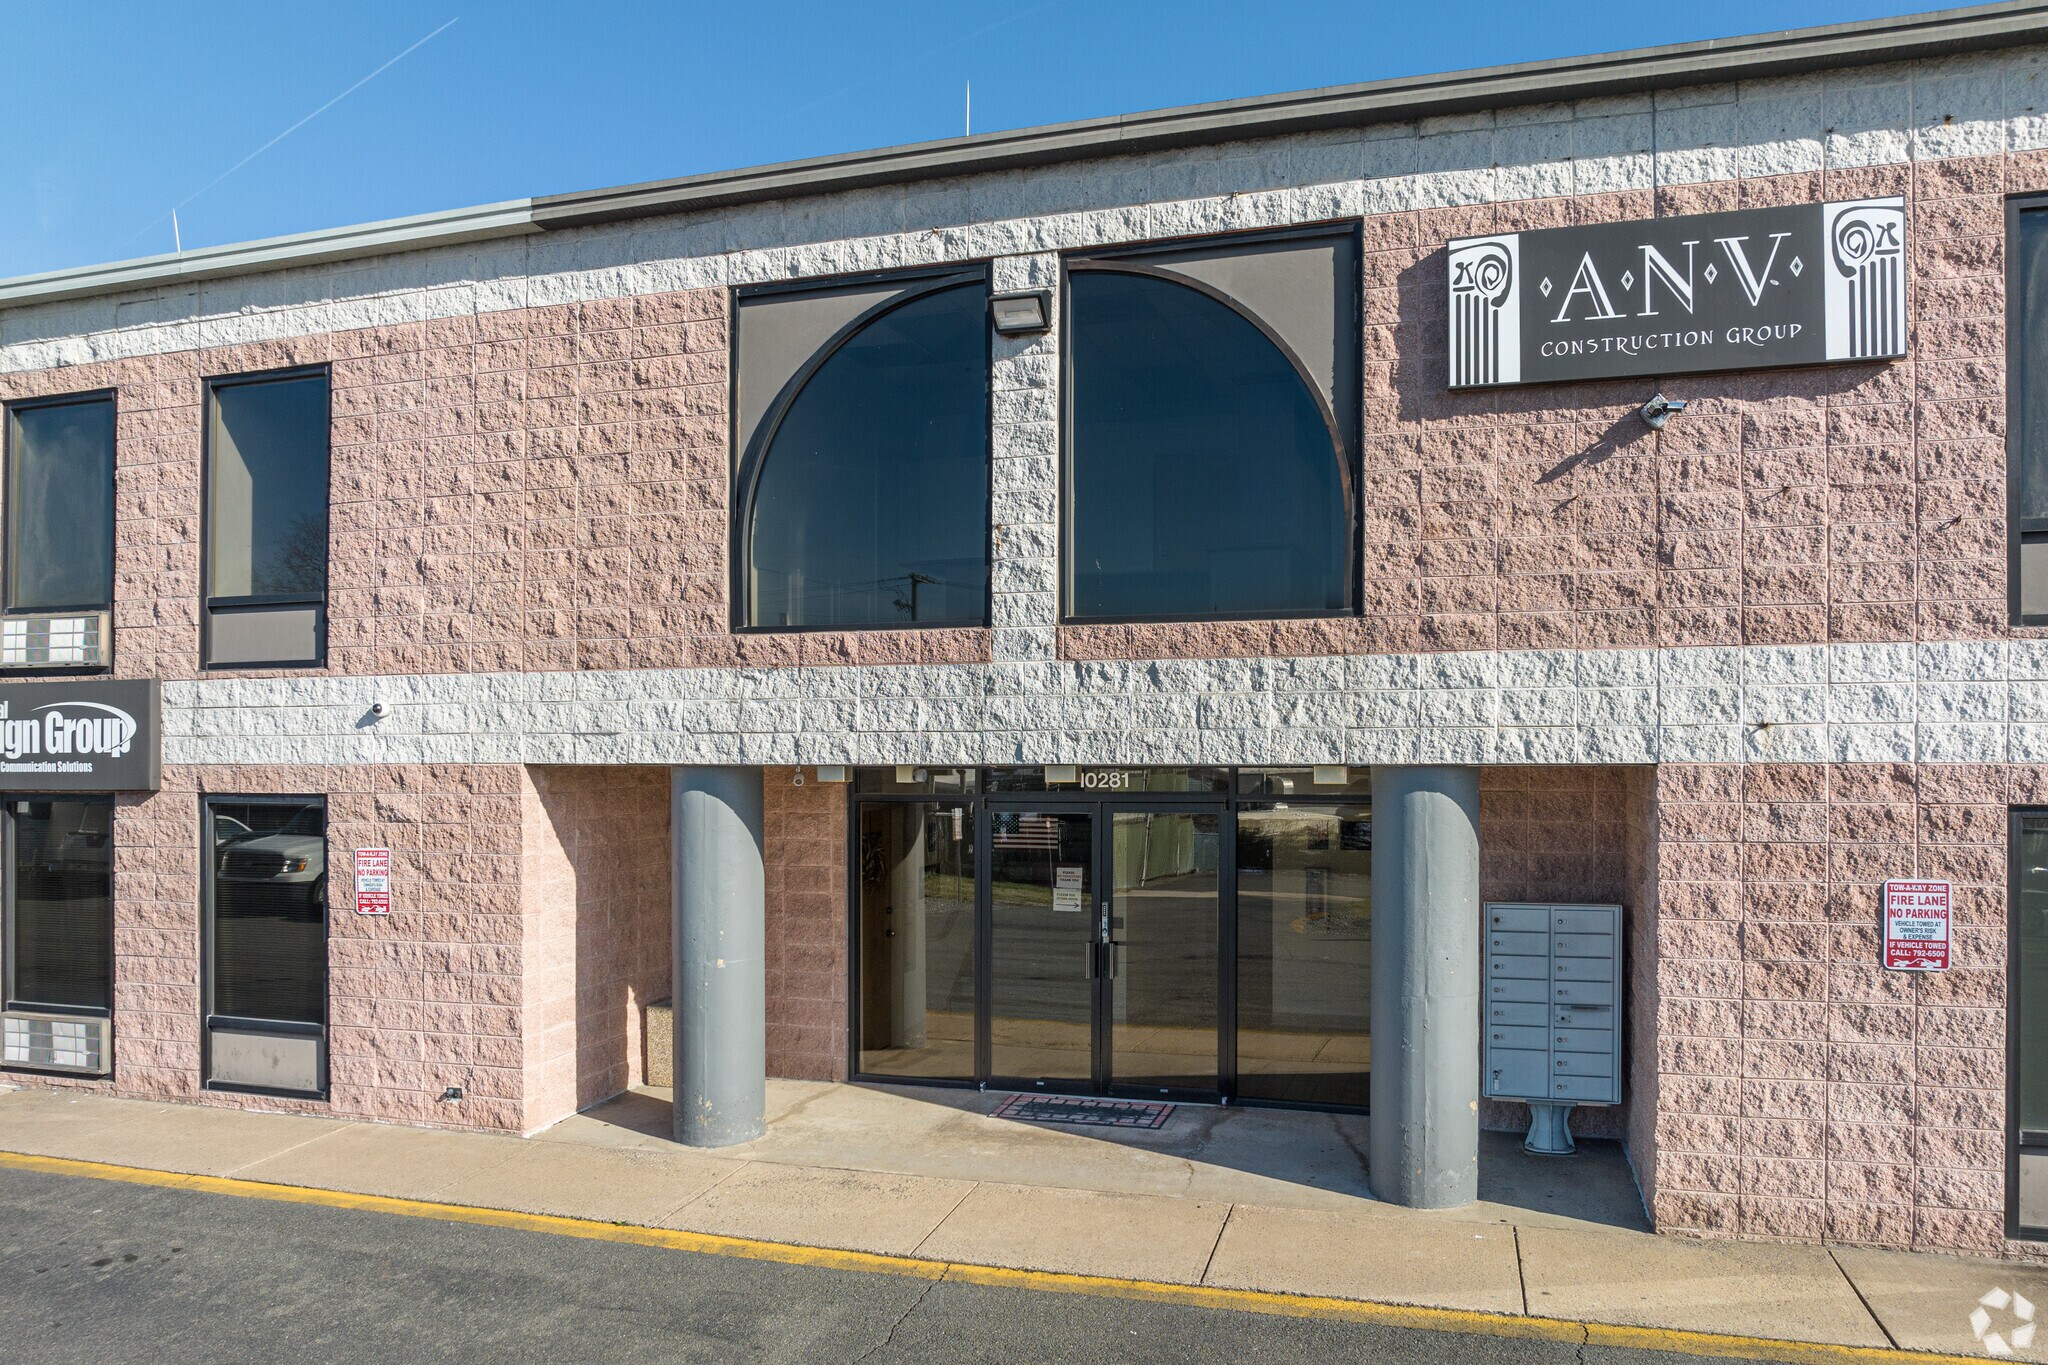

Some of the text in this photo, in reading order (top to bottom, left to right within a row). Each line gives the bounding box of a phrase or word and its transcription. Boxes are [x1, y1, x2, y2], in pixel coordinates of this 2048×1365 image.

[1540, 323, 1802, 357] CONSTRUCTION GROUP
[45, 710, 131, 758] Group
[0, 761, 93, 773] Communication Solutions
[1080, 772, 1129, 788] 10281
[358, 859, 388, 867] FIRE LANE
[1889, 884, 1947, 892] TOW-A-WAY ZONE
[1890, 895, 1947, 906] FIRE LANE
[1889, 908, 1947, 919] NO PARKING
[1924, 942, 1947, 950] TOWED
[1912, 949, 1945, 957] 792-6500
